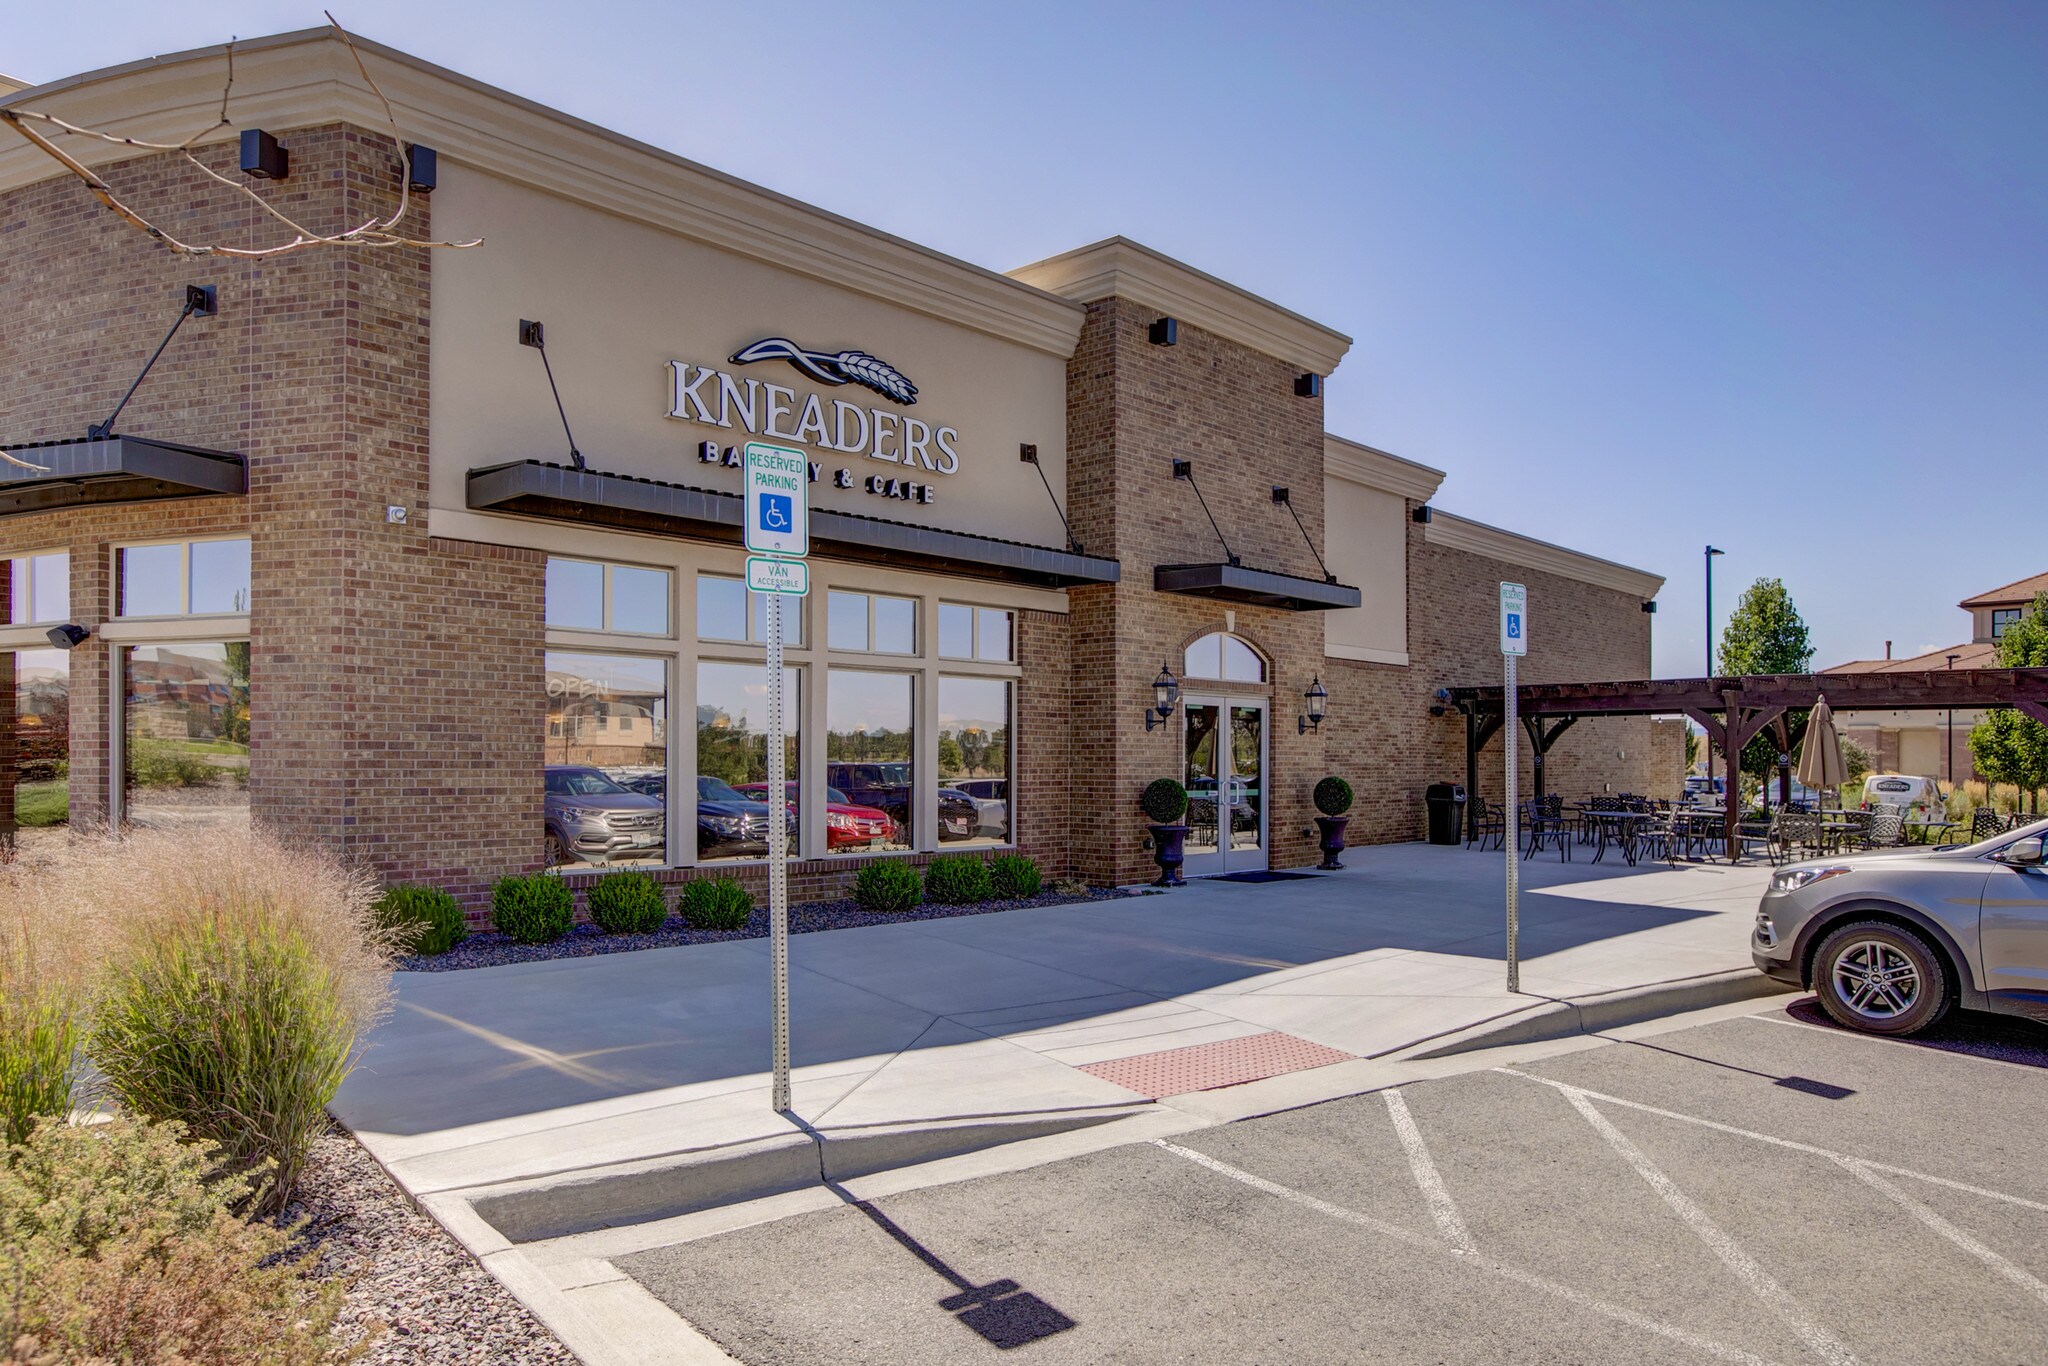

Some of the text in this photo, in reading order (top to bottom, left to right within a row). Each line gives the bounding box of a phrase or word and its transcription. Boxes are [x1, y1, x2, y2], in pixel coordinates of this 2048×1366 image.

[665, 360, 960, 475] KNEADERS
[698, 440, 935, 505] BAY & CAFE
[750, 452, 803, 474] RESERVED
[755, 472, 798, 491] PARKING
[767, 565, 789, 578] VAN
[757, 576, 799, 588] ACCESSIBLE
[1502, 589, 1524, 600] RESERVED
[1504, 602, 1522, 612] PARKING
[546, 679, 608, 700] OPEN
